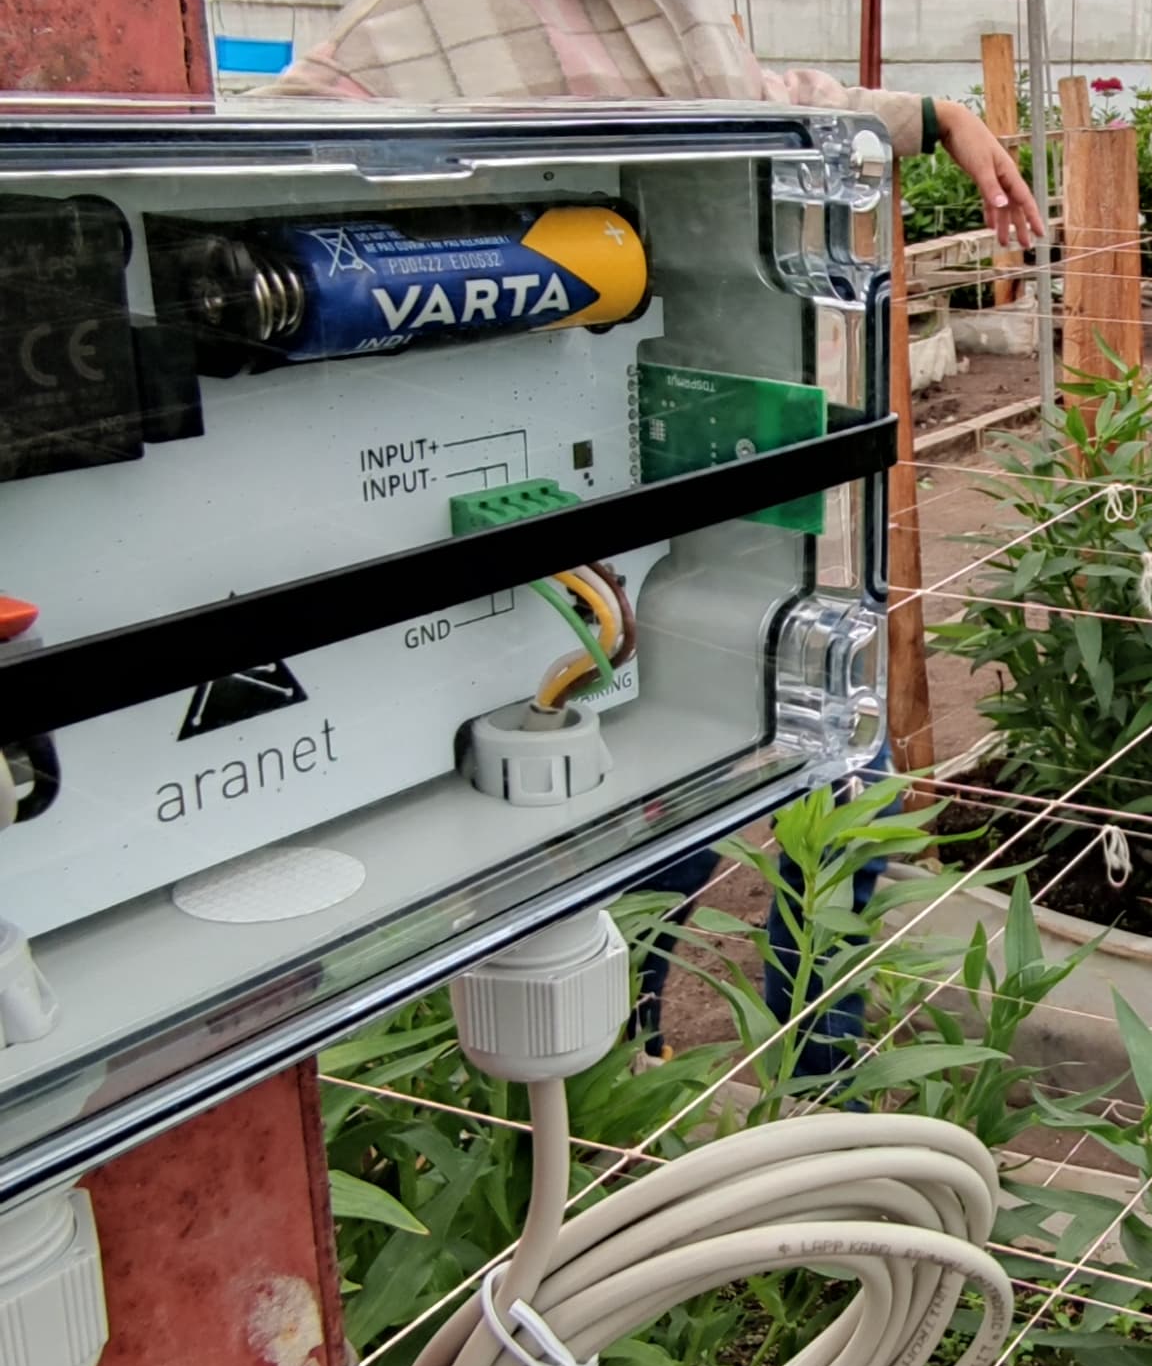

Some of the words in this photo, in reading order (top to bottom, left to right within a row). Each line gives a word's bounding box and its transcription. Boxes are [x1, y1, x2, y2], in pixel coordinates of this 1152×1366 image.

[372, 273, 570, 331] VARTA
[360, 438, 439, 472] INPUT+
[404, 618, 451, 649] GND
[156, 718, 338, 822] aranet
